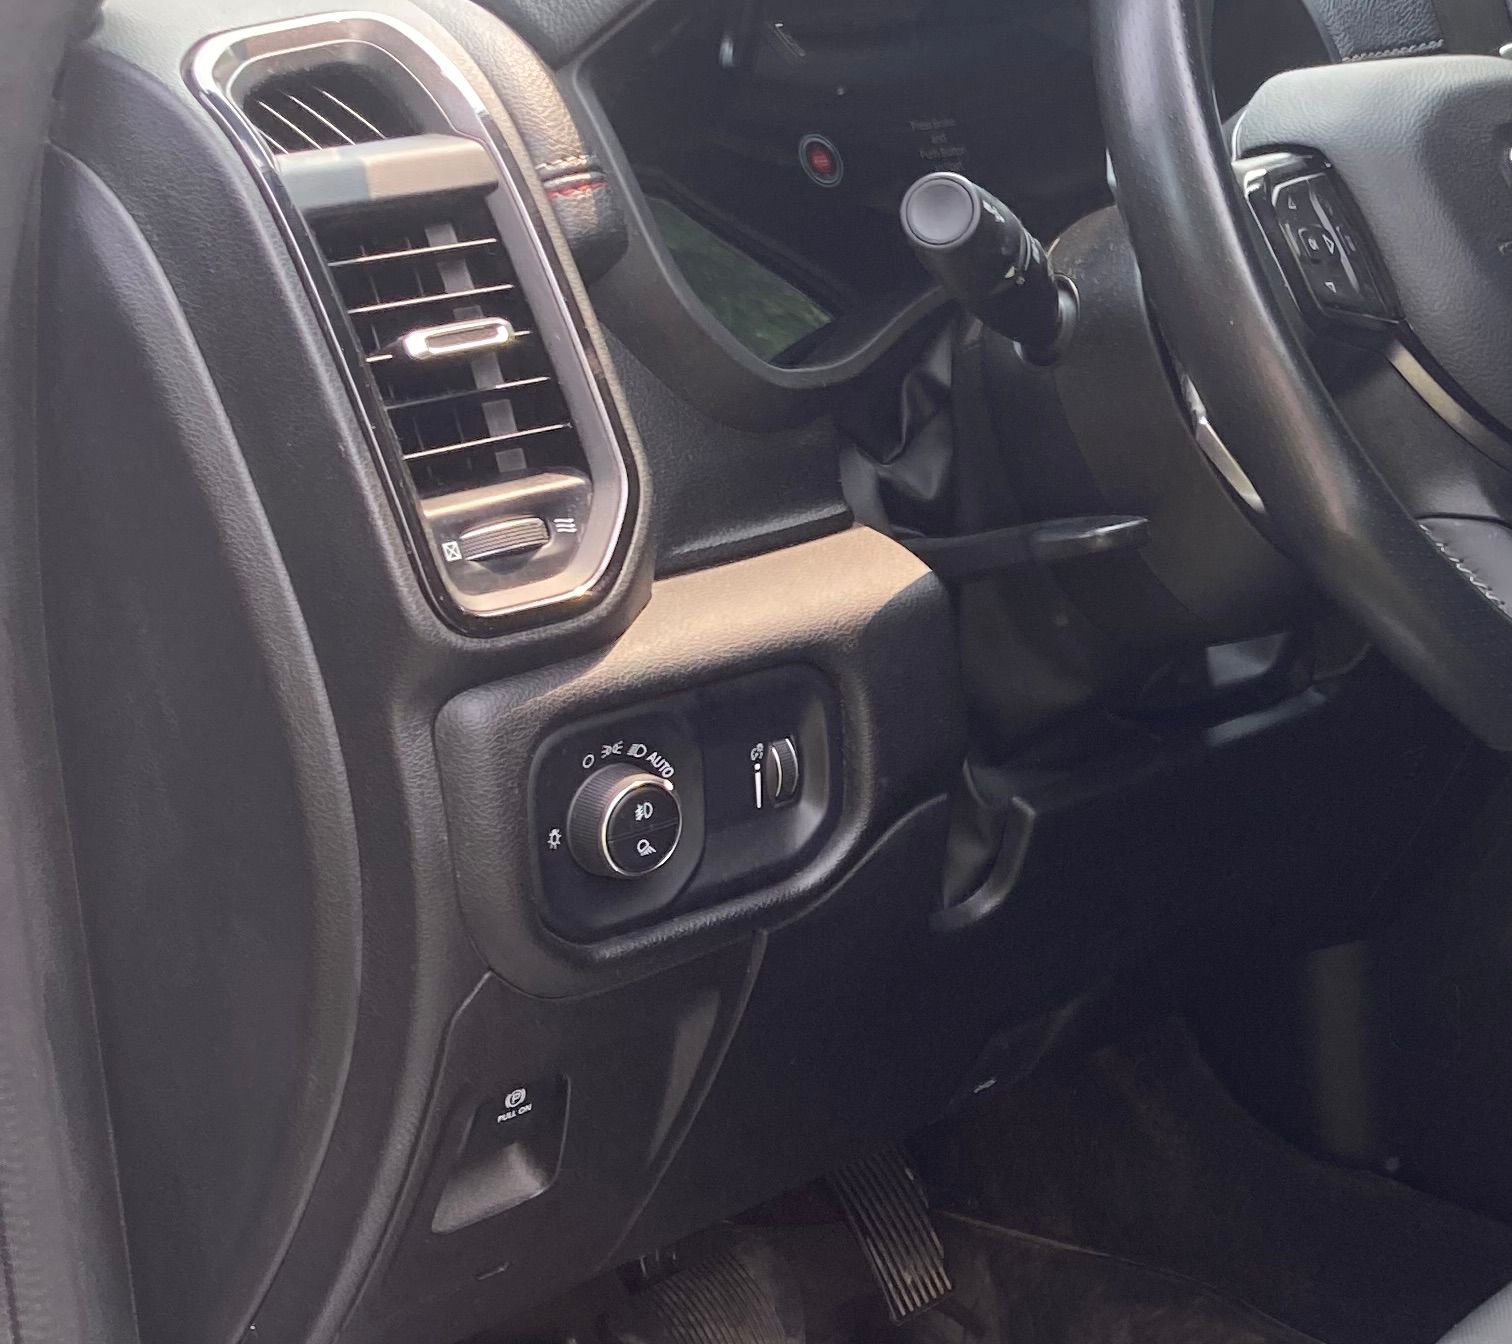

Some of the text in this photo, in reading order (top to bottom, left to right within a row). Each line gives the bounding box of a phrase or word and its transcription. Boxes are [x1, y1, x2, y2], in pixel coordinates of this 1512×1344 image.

[645, 751, 675, 778] AUTO
[497, 1103, 533, 1124] PULL ON
